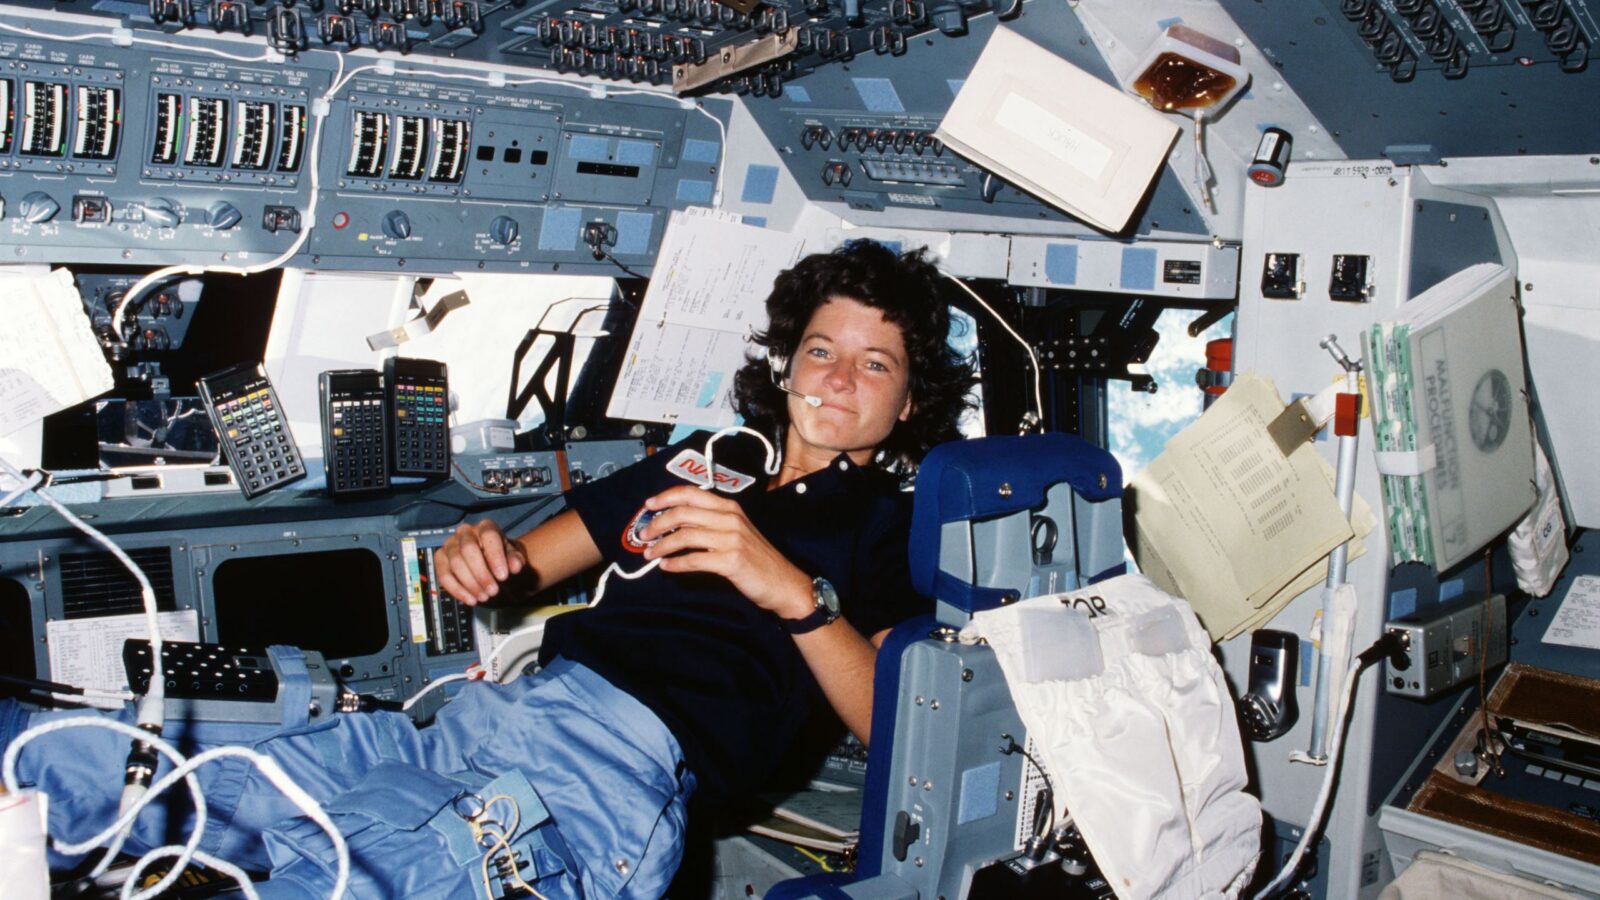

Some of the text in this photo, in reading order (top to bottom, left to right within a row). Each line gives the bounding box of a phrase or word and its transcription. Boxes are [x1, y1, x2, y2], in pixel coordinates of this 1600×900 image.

[678, 459, 741, 488] NASA
[1425, 375, 1448, 491] PROCEDURES
[1436, 360, 1458, 489] MALFUNCTION
